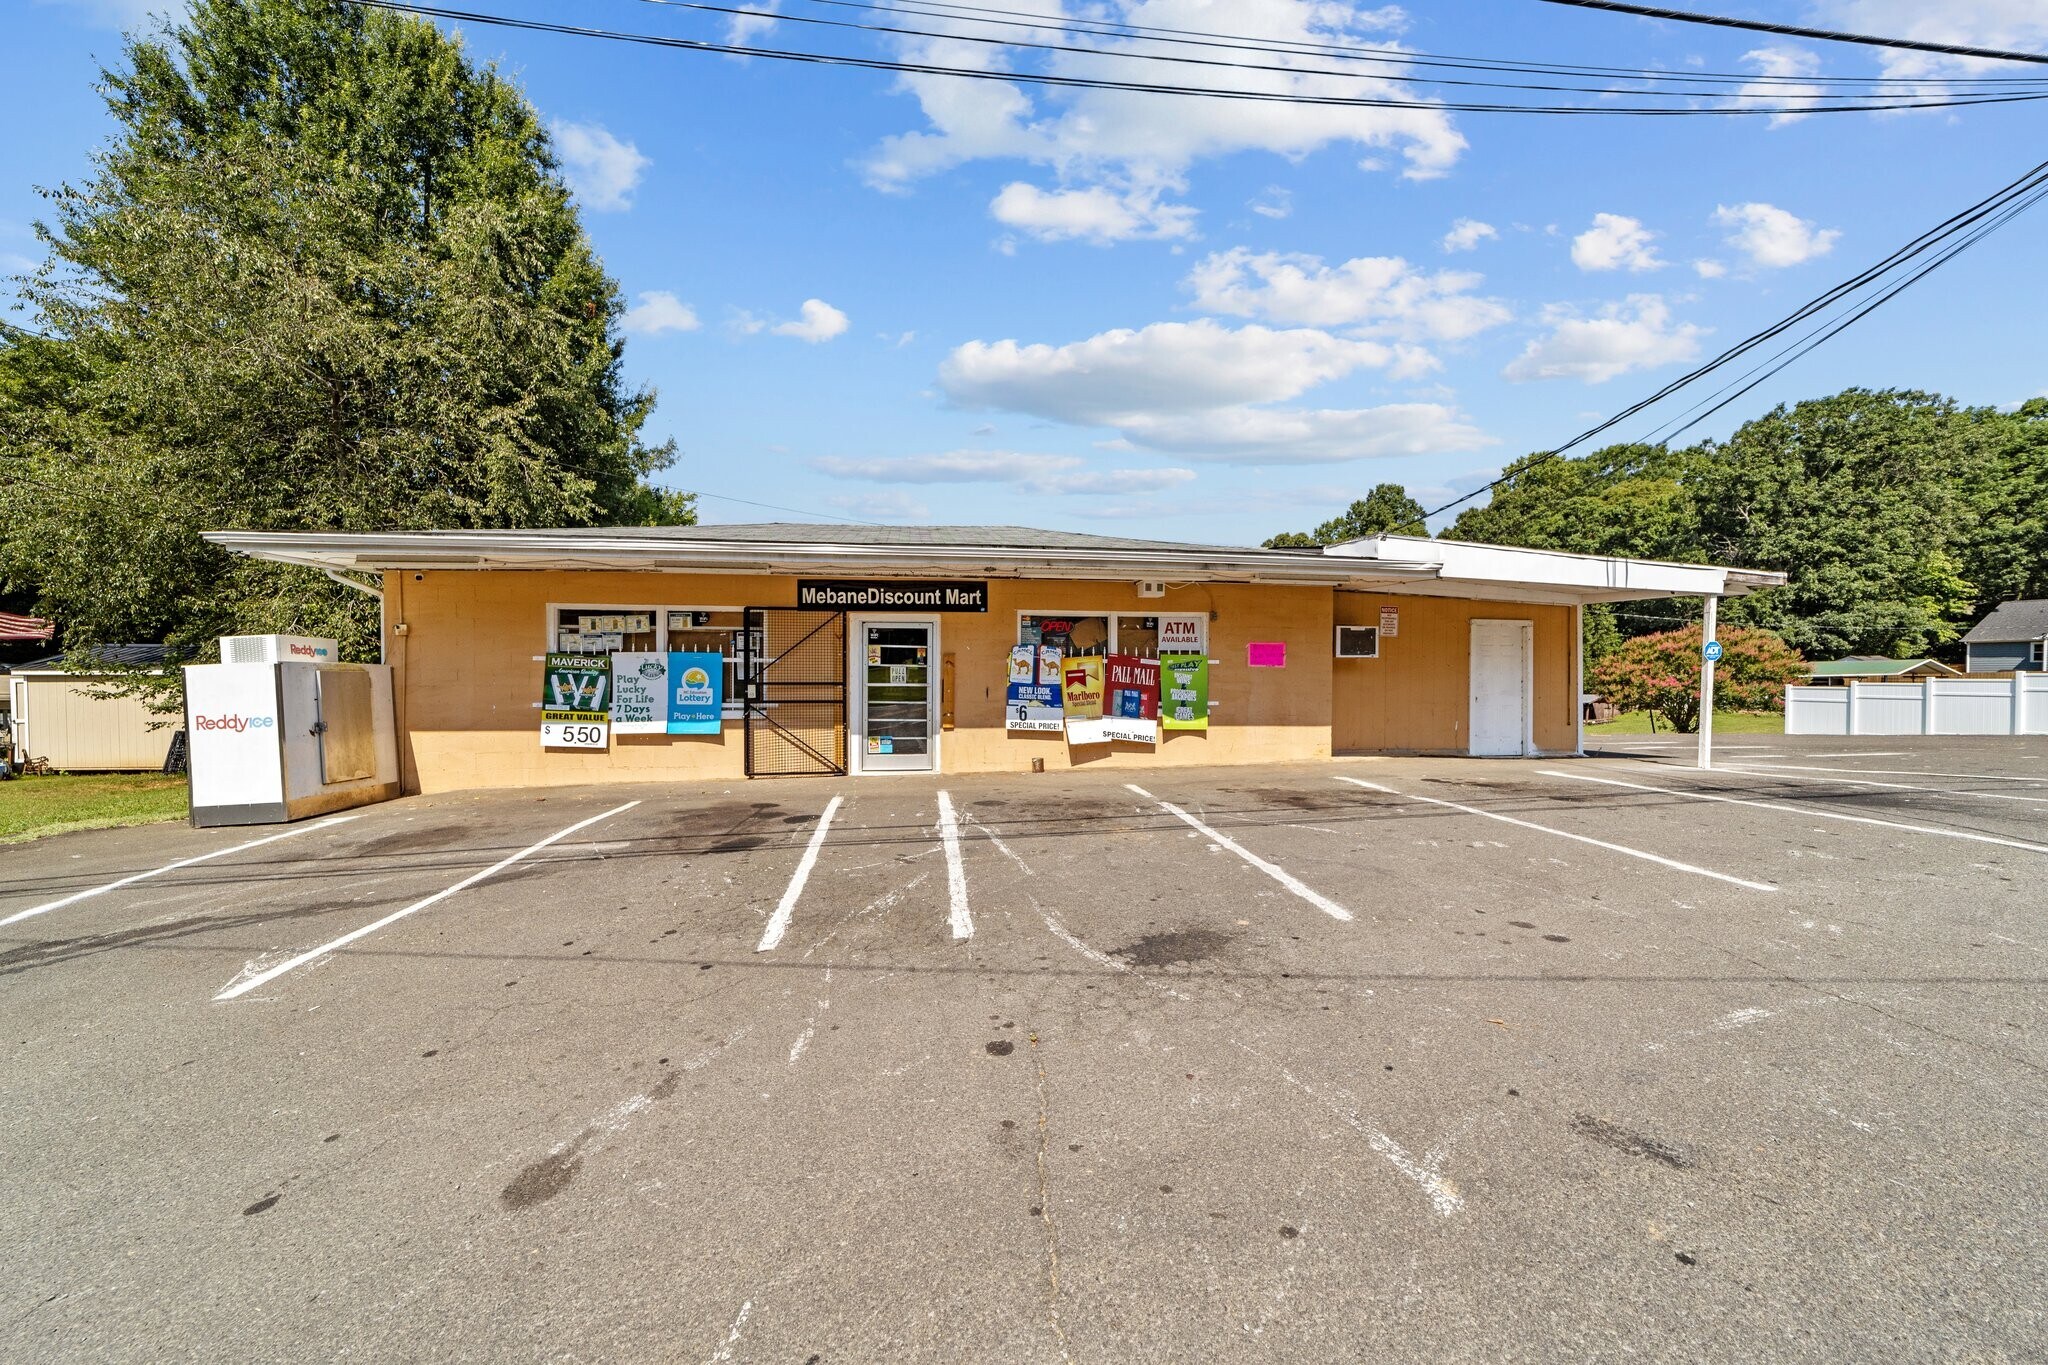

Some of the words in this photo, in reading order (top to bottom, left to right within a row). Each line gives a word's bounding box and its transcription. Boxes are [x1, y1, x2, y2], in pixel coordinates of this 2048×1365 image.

[945, 588, 982, 605] Mart
[1041, 621, 1071, 633] OPEN
[1164, 622, 1196, 635] ATM
[1706, 646, 1720, 655] ADT
[551, 657, 606, 668] MAVERICK
[641, 662, 664, 671] Lucky
[616, 674, 640, 684] Play
[1112, 665, 1131, 684] PALL
[1133, 667, 1155, 686] MALL
[616, 685, 647, 695] Lucky
[1018, 686, 1033, 695] NEW
[616, 695, 633, 704] For
[635, 694, 655, 704] Life
[679, 693, 711, 704] Lottery
[1066, 690, 1101, 702] Marlboro
[616, 705, 622, 714] 7
[624, 705, 651, 716] Days
[545, 713, 575, 721] GREAT
[576, 713, 605, 722] VALUE
[625, 714, 653, 723] Week
[673, 712, 691, 721] Play
[695, 712, 715, 721] Here
[1010, 721, 1037, 729] SPECIAL
[1038, 722, 1060, 730] PRICE!
[544, 725, 551, 735] $
[562, 726, 601, 744] 5.50
[1102, 730, 1132, 740] SPECIAL
